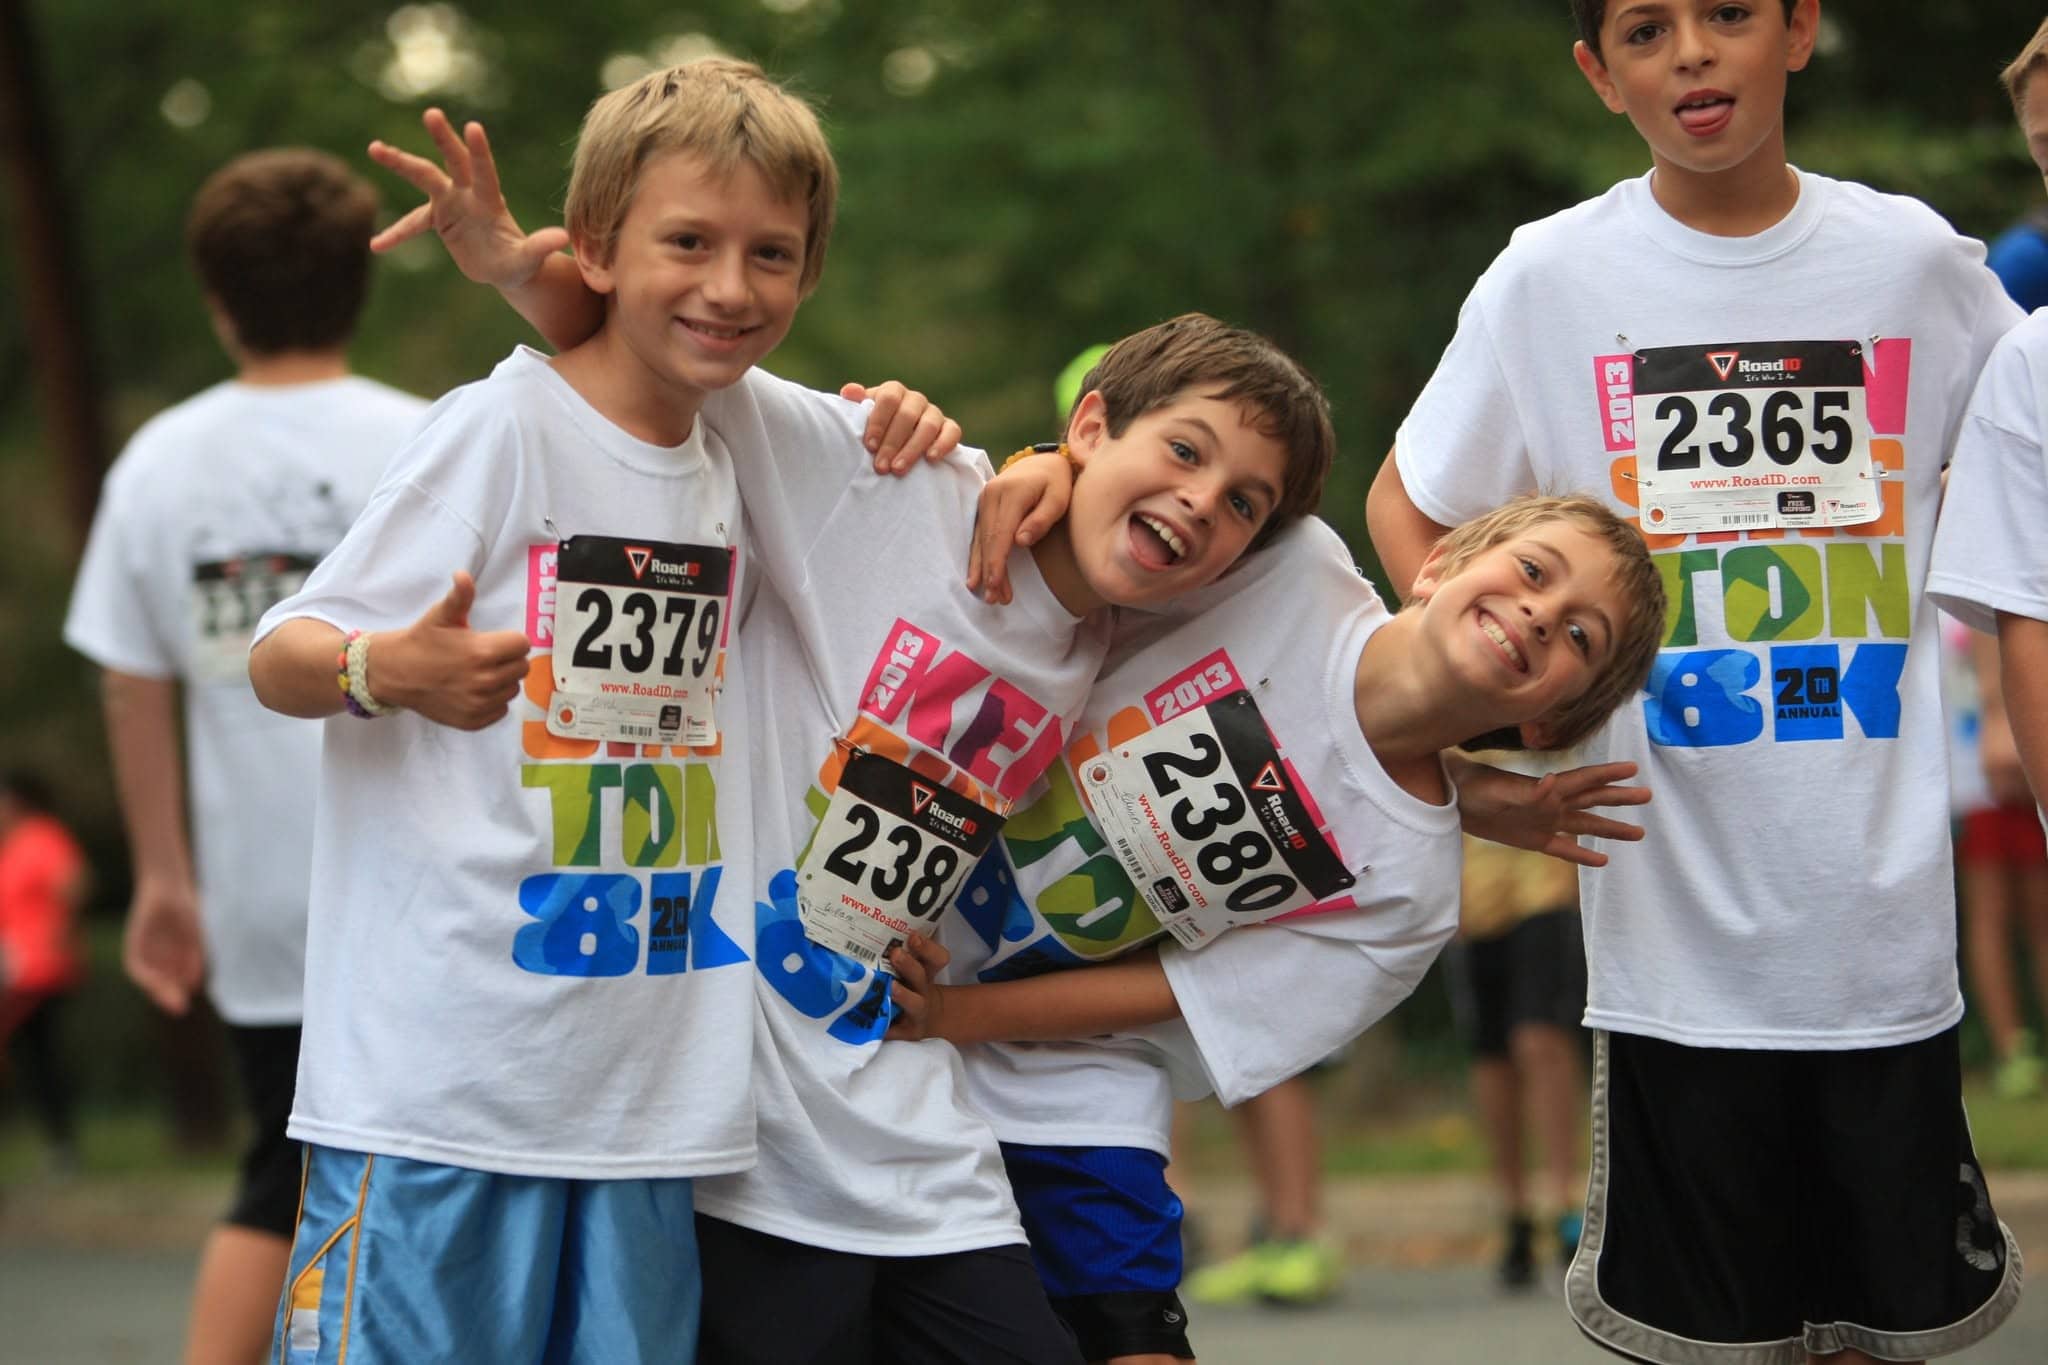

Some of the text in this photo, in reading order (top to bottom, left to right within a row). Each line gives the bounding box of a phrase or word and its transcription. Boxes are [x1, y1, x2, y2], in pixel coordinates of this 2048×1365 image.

[1738, 358, 1802, 373] RoadID
[1605, 360, 1634, 444] 2013
[1655, 390, 1853, 472] 2365
[1688, 473, 1822, 489] www.RoadID.com
[572, 588, 720, 678] 2379
[601, 682, 689, 699] www.RoadID.com
[867, 629, 924, 711] 2013
[1154, 661, 1233, 722] 2013
[1776, 706, 1841, 720] ANNUAL
[928, 800, 978, 835] RoadID
[1142, 733, 1298, 912] 2380
[1266, 793, 1307, 850] RoadID
[1138, 793, 1209, 909] www.RoadID.com
